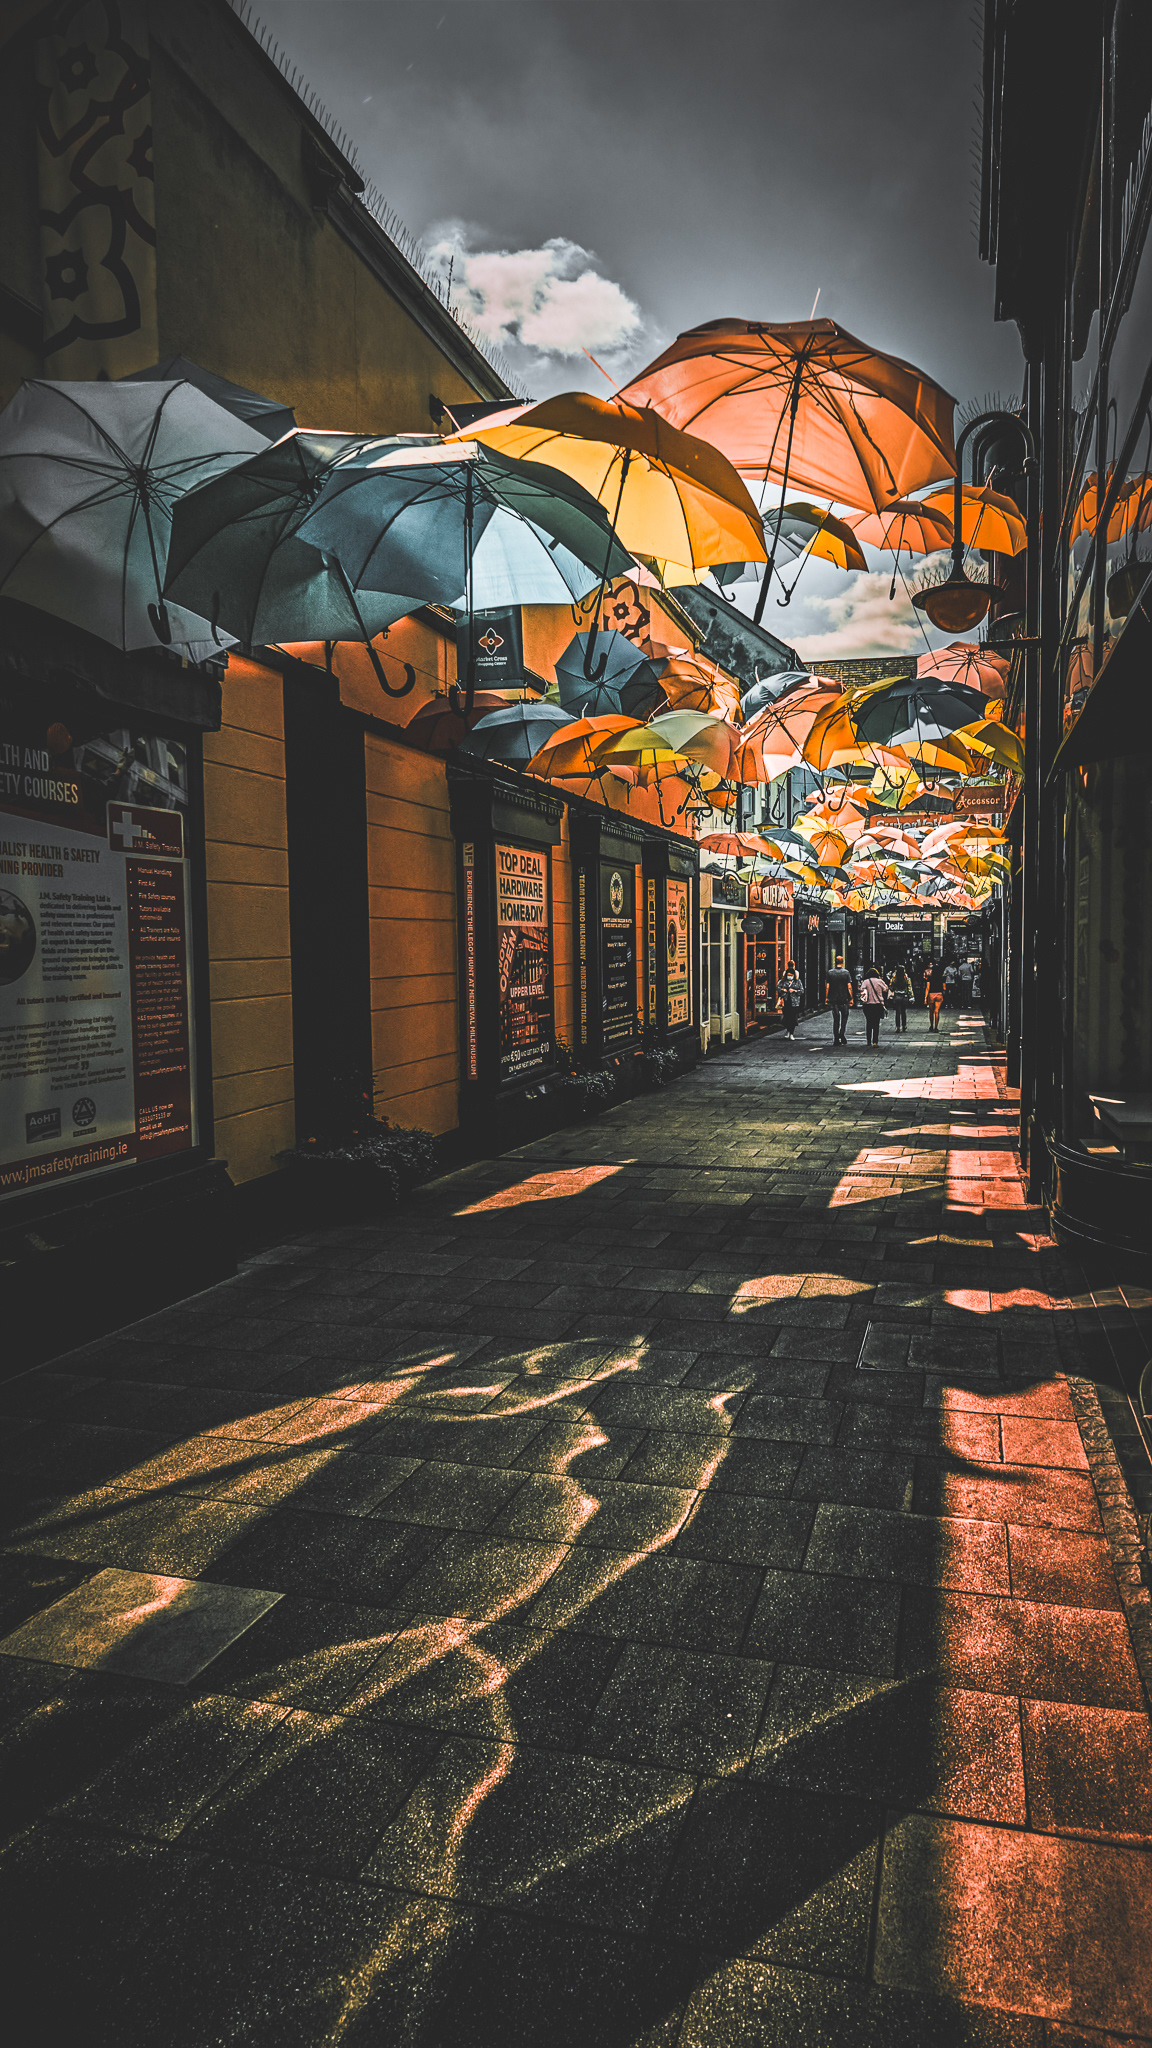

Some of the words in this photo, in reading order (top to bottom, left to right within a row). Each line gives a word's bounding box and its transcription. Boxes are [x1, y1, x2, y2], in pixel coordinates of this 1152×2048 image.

[24, 748, 49, 772] AND
[24, 776, 78, 804] COURSES
[29, 844, 61, 860] HEALTH
[64, 848, 69, 860] &
[70, 848, 100, 863] SAFETY
[499, 851, 518, 872] TOP
[520, 856, 542, 876] DEAL
[22, 862, 64, 878] PROVIDER
[52, 893, 71, 902] Safety
[72, 894, 95, 903] Training
[500, 878, 543, 898] HARDWARE
[500, 902, 543, 922] HOME&DIY
[885, 922, 904, 930] Dealz
[498, 932, 508, 974] NOW
[500, 928, 517, 992] OPEN
[510, 986, 528, 998] UPPER
[529, 984, 544, 995] LEVEL
[30, 1112, 57, 1126] AoHT
